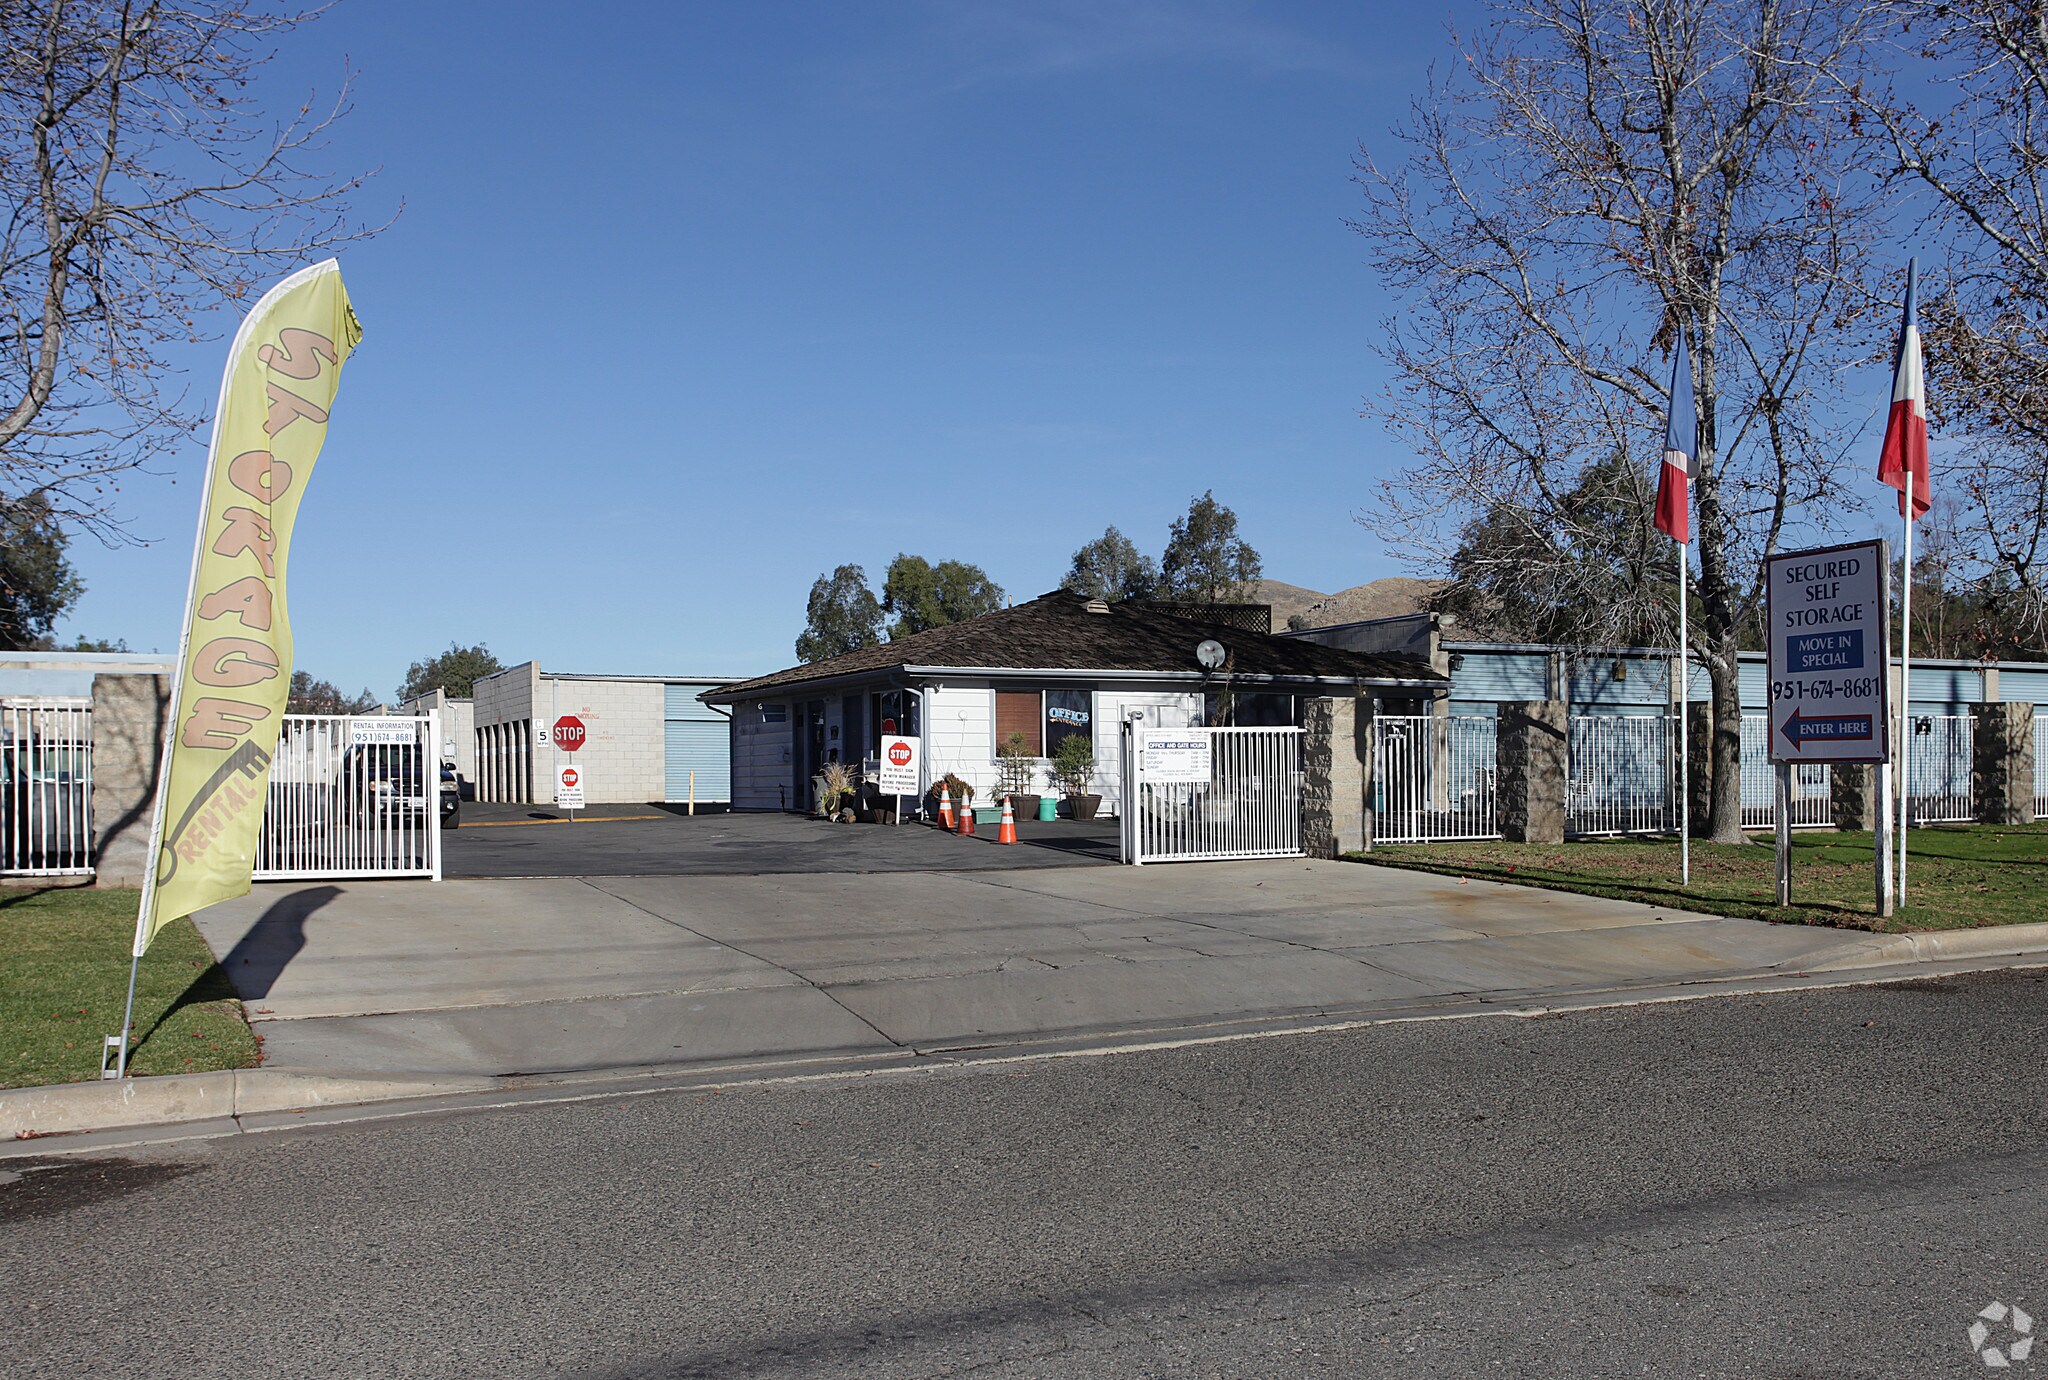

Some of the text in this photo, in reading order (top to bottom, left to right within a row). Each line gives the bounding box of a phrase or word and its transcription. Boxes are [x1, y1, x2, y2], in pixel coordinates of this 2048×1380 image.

[1786, 558, 1860, 584] SECURED
[1806, 582, 1840, 602] SELF
[1786, 604, 1862, 628] STORAGE
[1798, 635, 1852, 651] MOVE IN
[1802, 652, 1848, 667] SPECIAL
[1773, 676, 1880, 700] 951-674-8681
[1049, 707, 1089, 722] OFFICE
[555, 727, 584, 740] STOP
[1800, 721, 1867, 735] ENTER HERE
[352, 733, 412, 742] (951)674-8681
[540, 732, 547, 741] 5
[890, 749, 910, 759] STOP
[563, 774, 577, 782] STOP
[178, 776, 257, 864] RENTAL
